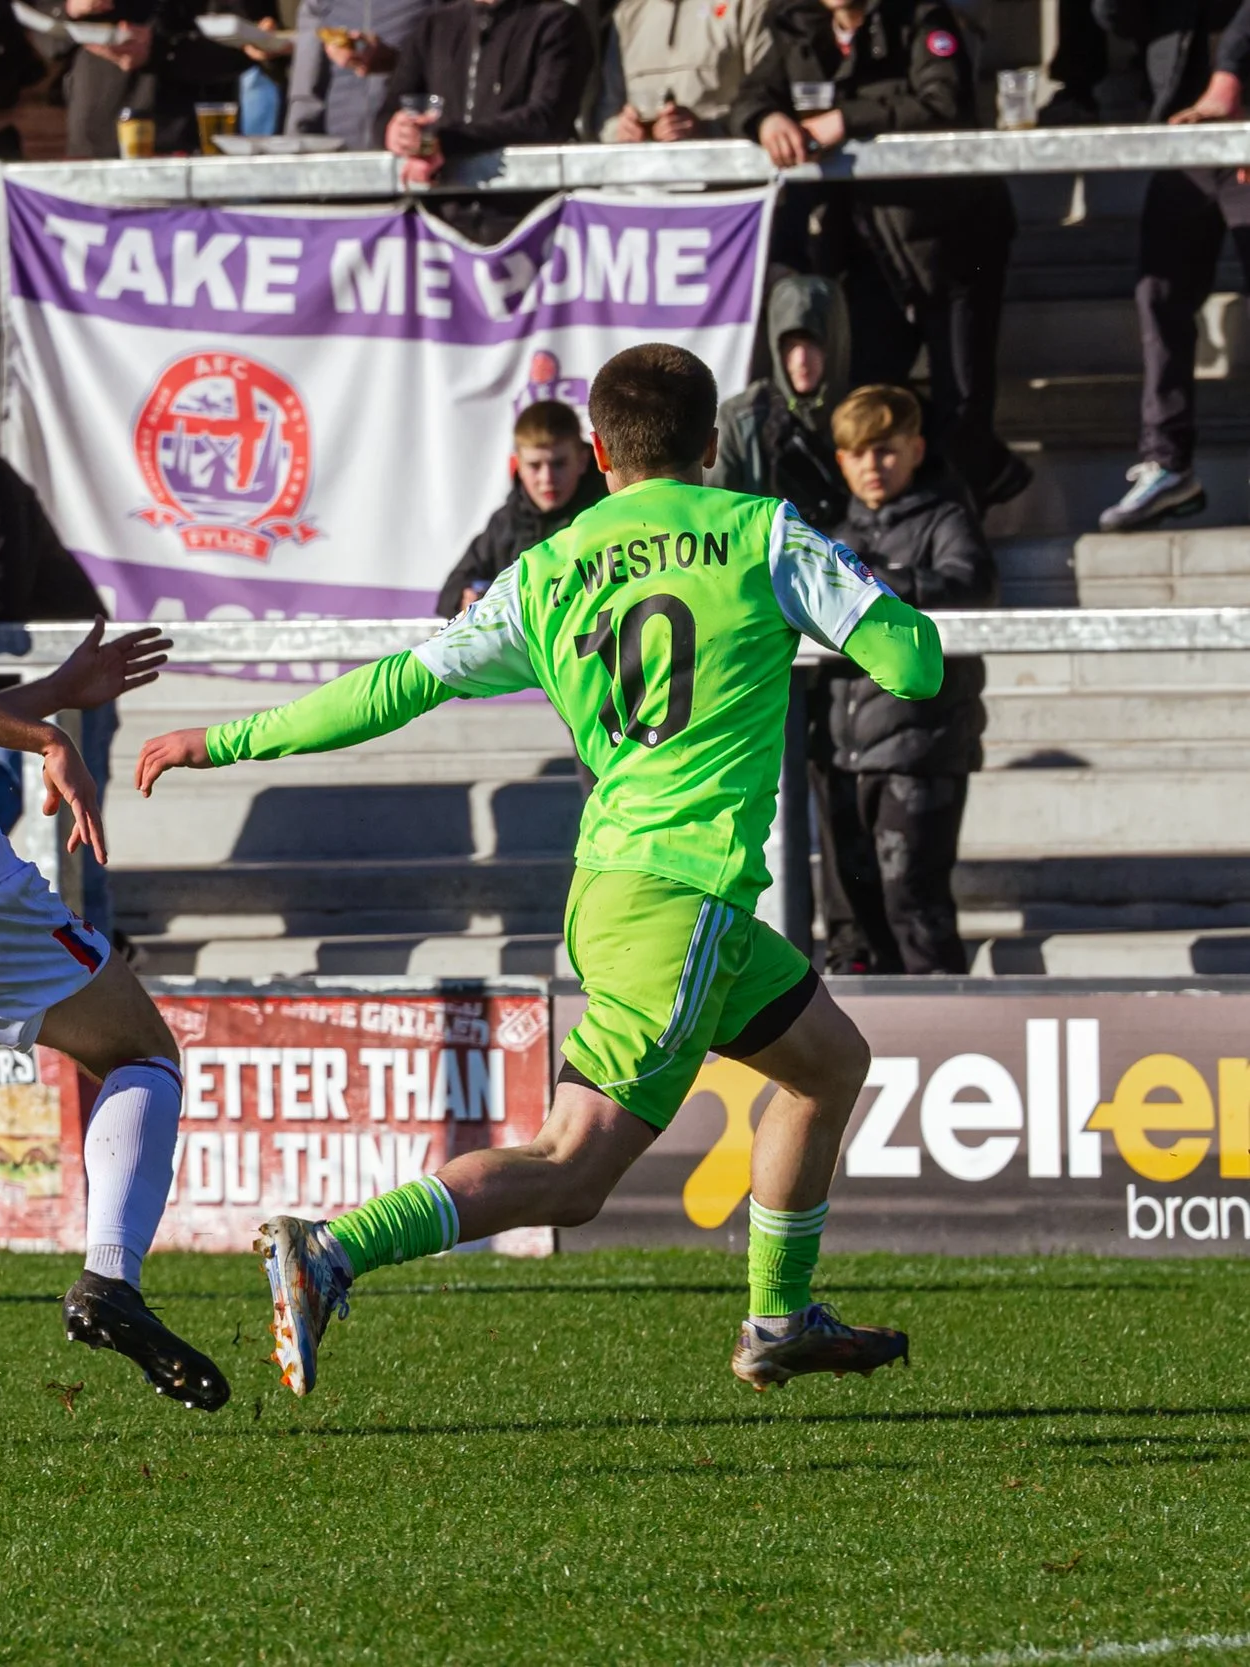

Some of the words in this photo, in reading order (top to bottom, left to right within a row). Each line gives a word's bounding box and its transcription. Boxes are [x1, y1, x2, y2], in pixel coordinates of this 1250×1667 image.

[44, 213, 303, 315] TAKE
[331, 236, 453, 318] ME
[471, 225, 711, 323] HOME
[194, 354, 249, 380] AFC
[575, 531, 729, 595] WESTON
[574, 593, 696, 749] 10
[179, 1047, 350, 1120] ETTER
[359, 1047, 507, 1121] THAN
[274, 1132, 432, 1206] THINK
